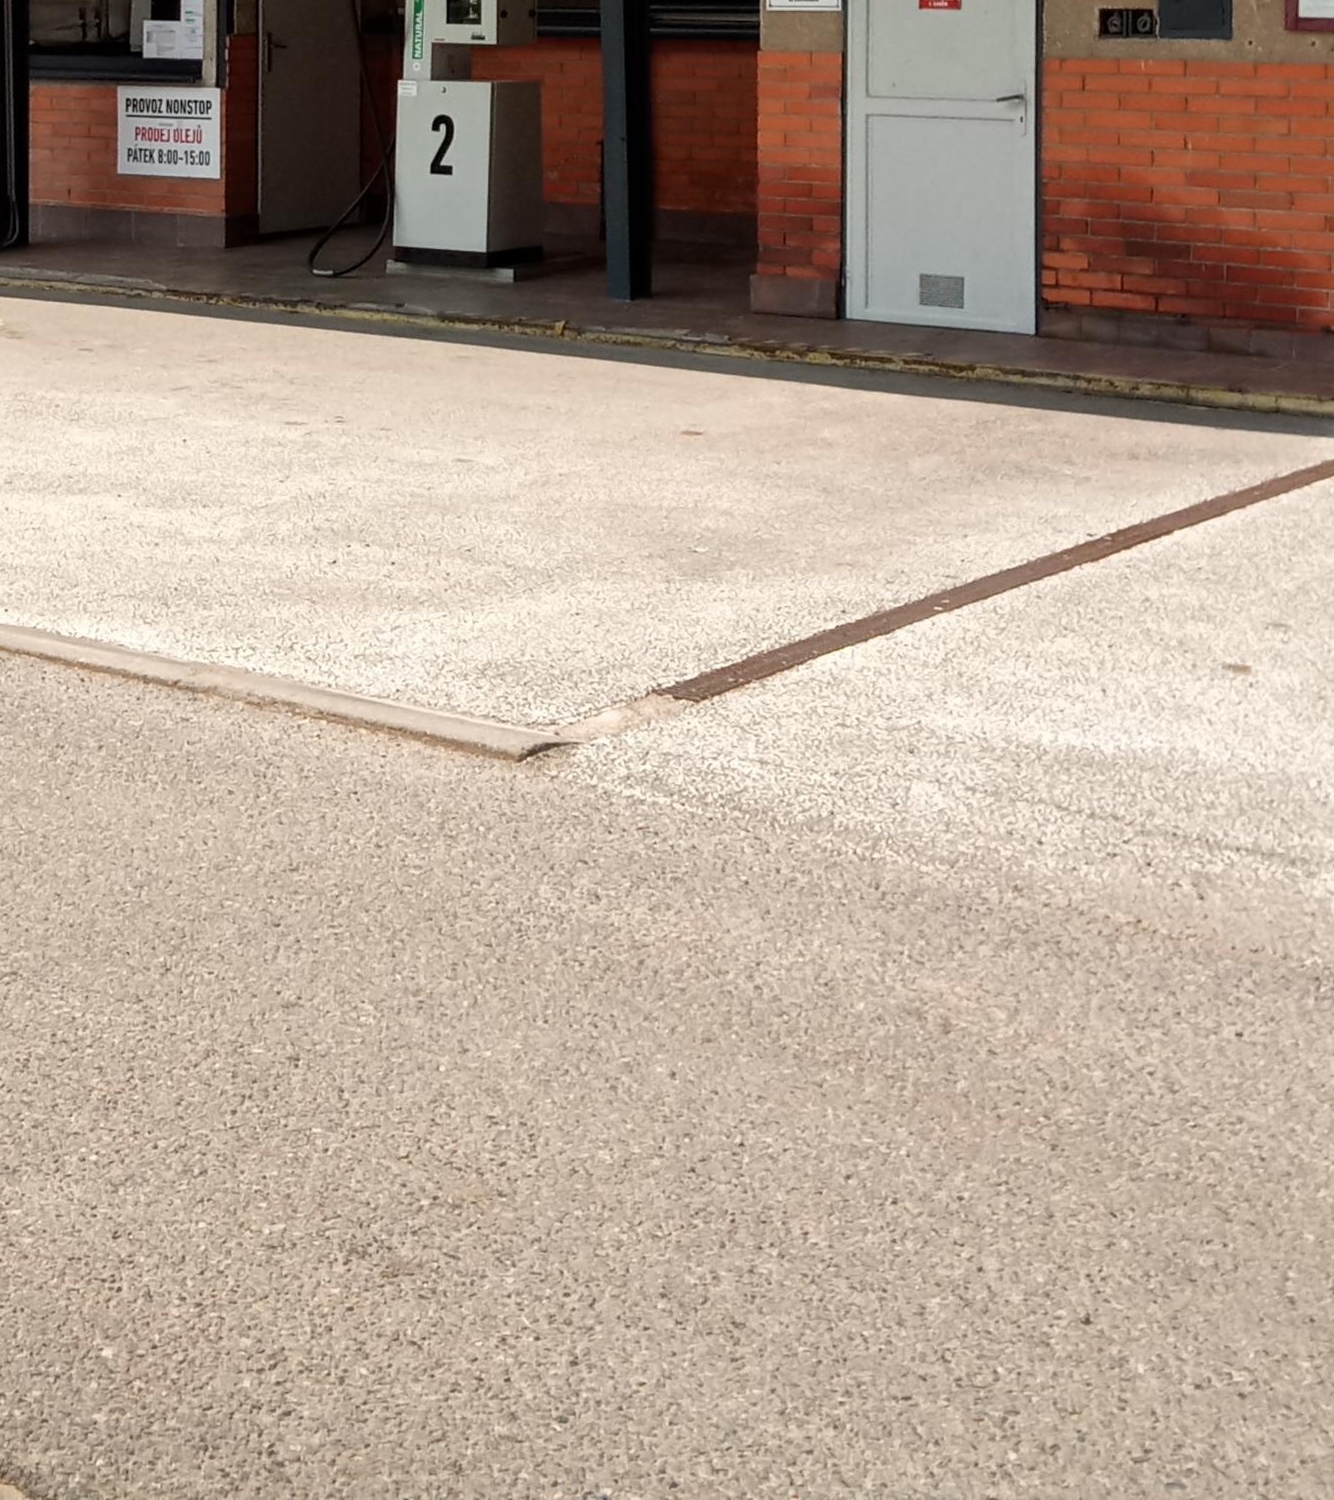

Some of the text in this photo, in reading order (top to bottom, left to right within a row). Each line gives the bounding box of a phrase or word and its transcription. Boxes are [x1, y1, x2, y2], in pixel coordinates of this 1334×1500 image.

[414, 11, 424, 59] NATURAL
[125, 97, 212, 115] PROVOZ NONSTOP
[134, 124, 203, 144] PRODEJ OLEJŮ
[127, 143, 155, 164] PÁTEK
[430, 114, 455, 176] 2
